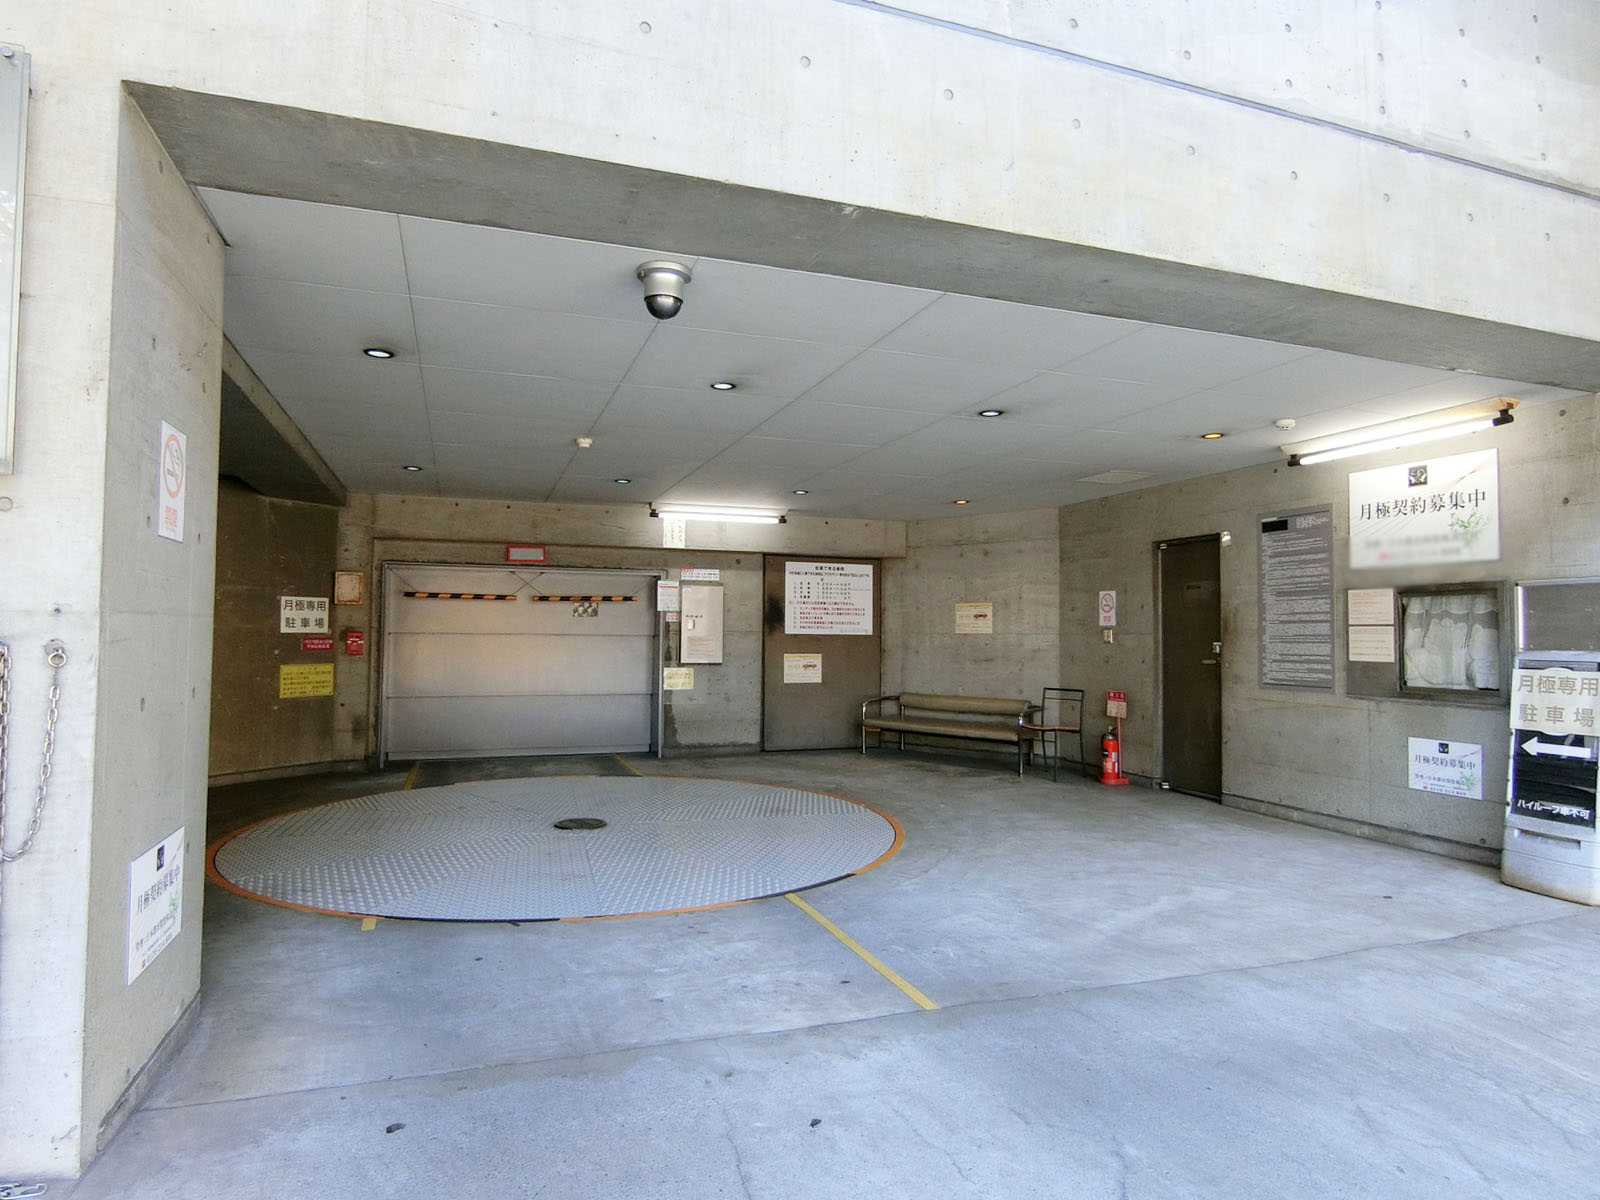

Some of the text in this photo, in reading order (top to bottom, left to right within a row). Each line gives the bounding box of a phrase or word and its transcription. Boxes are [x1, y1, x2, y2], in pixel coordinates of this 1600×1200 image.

[1359, 488, 1486, 521] 月極契約募集中
[283, 599, 326, 612] 月極専用
[285, 617, 325, 629] 駐車場
[1517, 675, 1599, 697] 月極専用
[1518, 703, 1595, 728] 駐車場
[1415, 754, 1476, 770] 月極契約募集中
[1517, 799, 1590, 820] ハイルーフ車不可
[137, 864, 180, 916] 月極契約募集中
